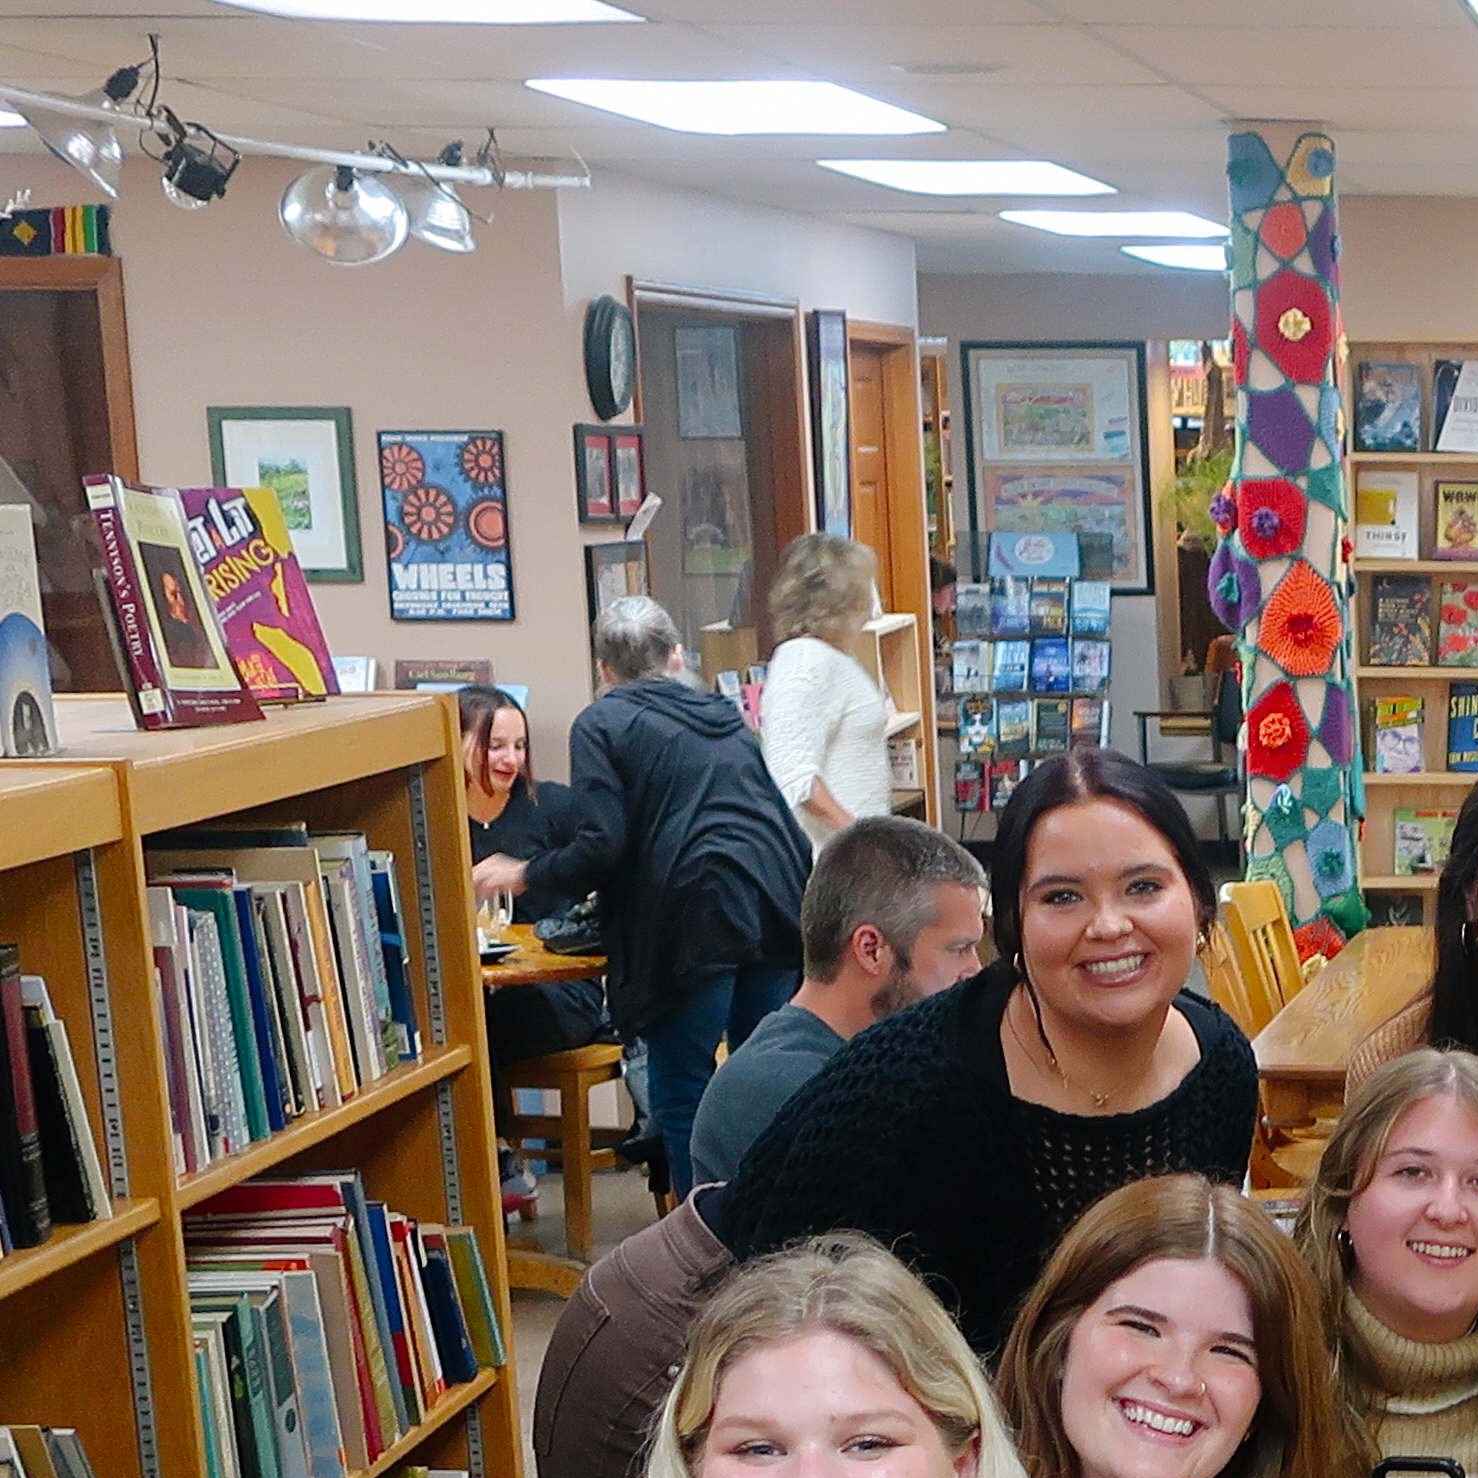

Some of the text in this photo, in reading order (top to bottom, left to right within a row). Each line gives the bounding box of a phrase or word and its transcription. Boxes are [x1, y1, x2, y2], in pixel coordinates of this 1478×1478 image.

[1365, 530, 1408, 541] THIRST
[99, 509, 146, 662] TENNYSON'S POETRY
[390, 563, 507, 590] WHEELS
